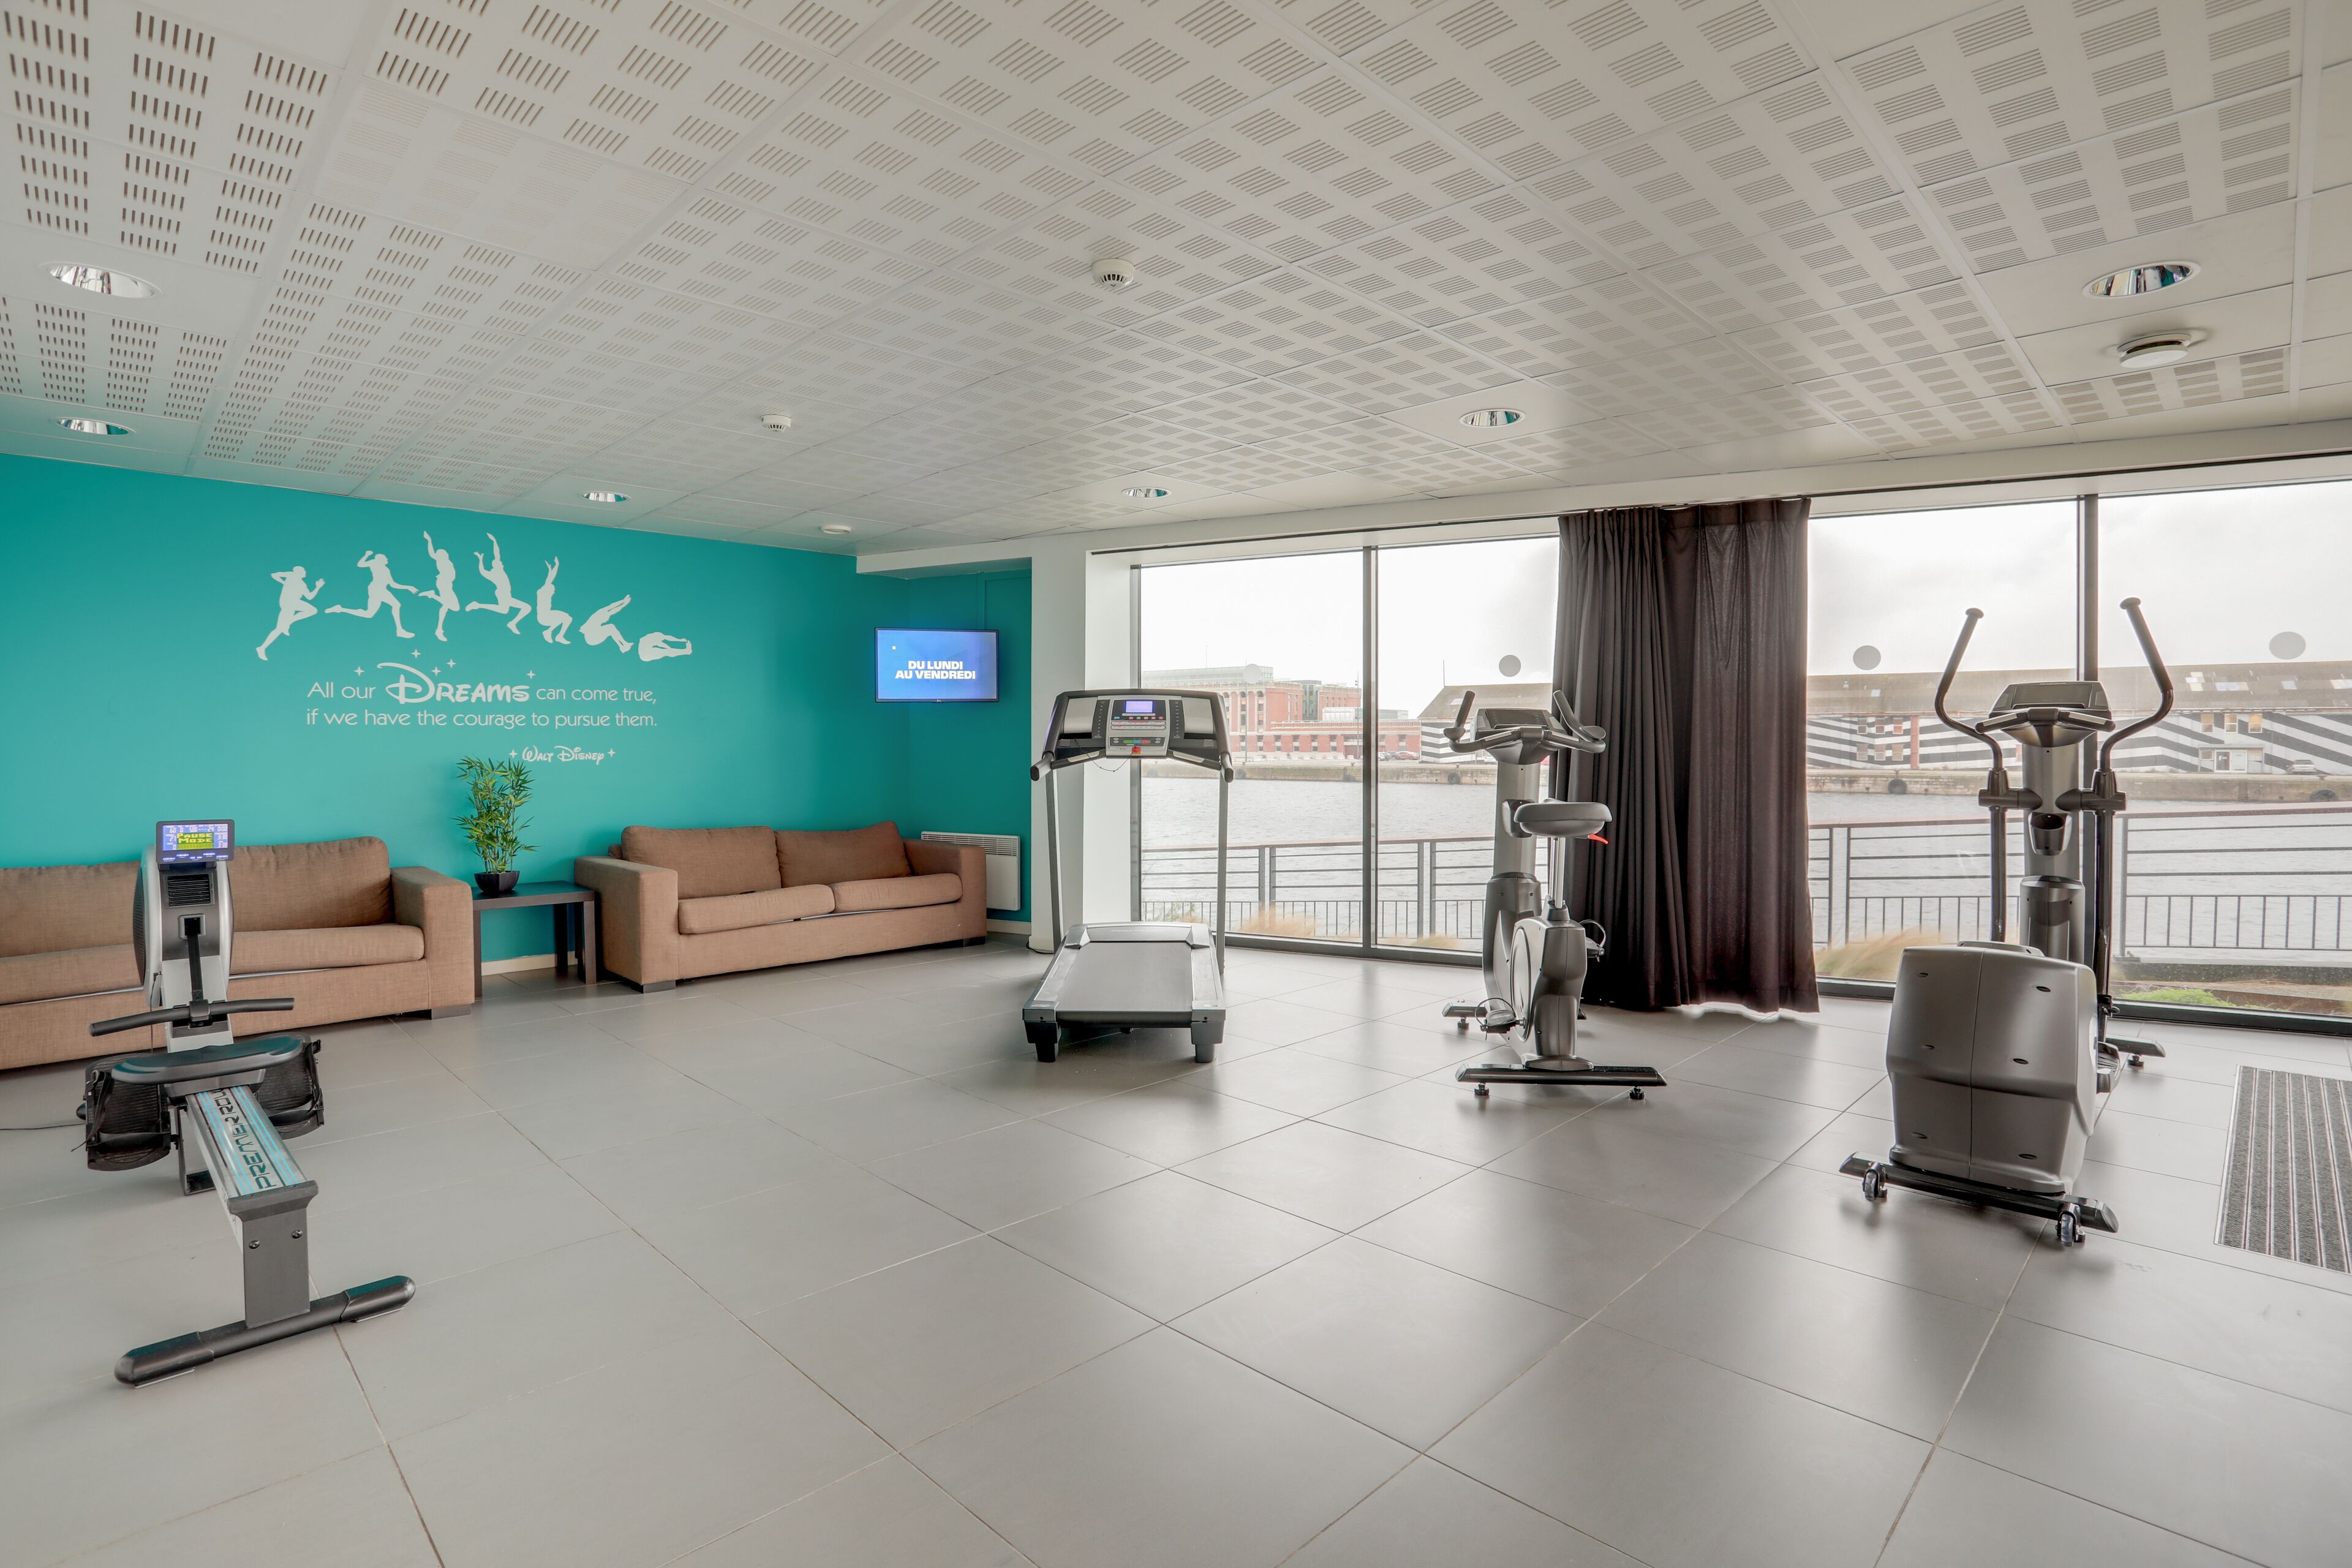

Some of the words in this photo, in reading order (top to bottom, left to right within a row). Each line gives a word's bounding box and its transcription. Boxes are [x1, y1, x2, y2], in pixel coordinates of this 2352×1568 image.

[908, 661, 925, 669] DU
[927, 661, 963, 670] LUNDI
[895, 670, 913, 679] AU
[915, 670, 976, 680] VENDREDI
[307, 682, 334, 698] All
[341, 686, 376, 699] our
[536, 688, 566, 701] can
[571, 689, 619, 701] come
[622, 687, 657, 705] true,
[307, 708, 319, 725] if
[323, 713, 358, 726] we
[364, 709, 412, 726] have
[417, 710, 447, 726] the
[453, 714, 526, 729] courage
[531, 712, 549, 726] to
[555, 715, 610, 729] pursue
[615, 712, 657, 726] them.
